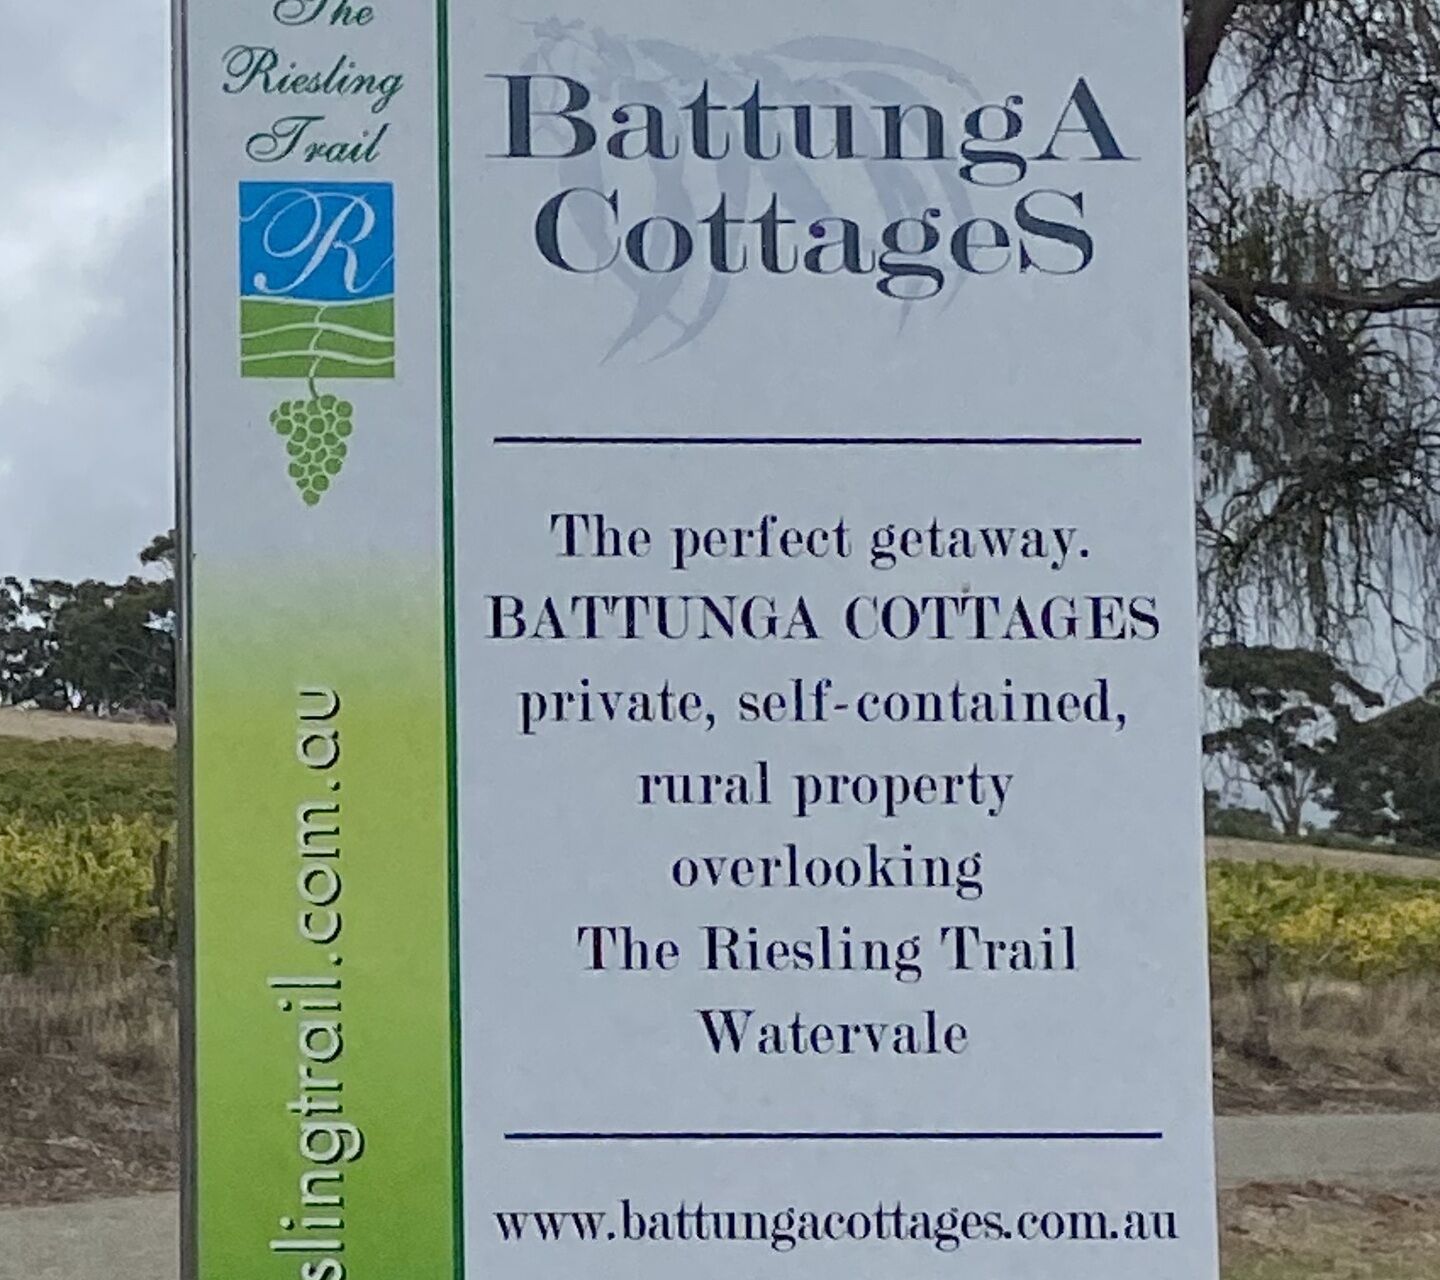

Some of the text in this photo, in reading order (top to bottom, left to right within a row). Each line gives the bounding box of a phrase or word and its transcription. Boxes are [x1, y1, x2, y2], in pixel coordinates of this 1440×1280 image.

[222, 44, 405, 114] Riesling
[245, 115, 391, 164] Trail
[485, 74, 1140, 187] BattungA
[532, 184, 1096, 301] CottageS
[550, 513, 1089, 571] The perfect getaway.
[486, 594, 1160, 641] BATTUNGA COTTAGES
[519, 677, 1126, 736] private, self-contained,
[638, 760, 1014, 819] rural property
[672, 842, 983, 901] overlooking
[577, 925, 1075, 983] The Riesling Trail
[698, 1008, 969, 1055] Watervale
[492, 1198, 1180, 1253] www.battungacottages.com.au
